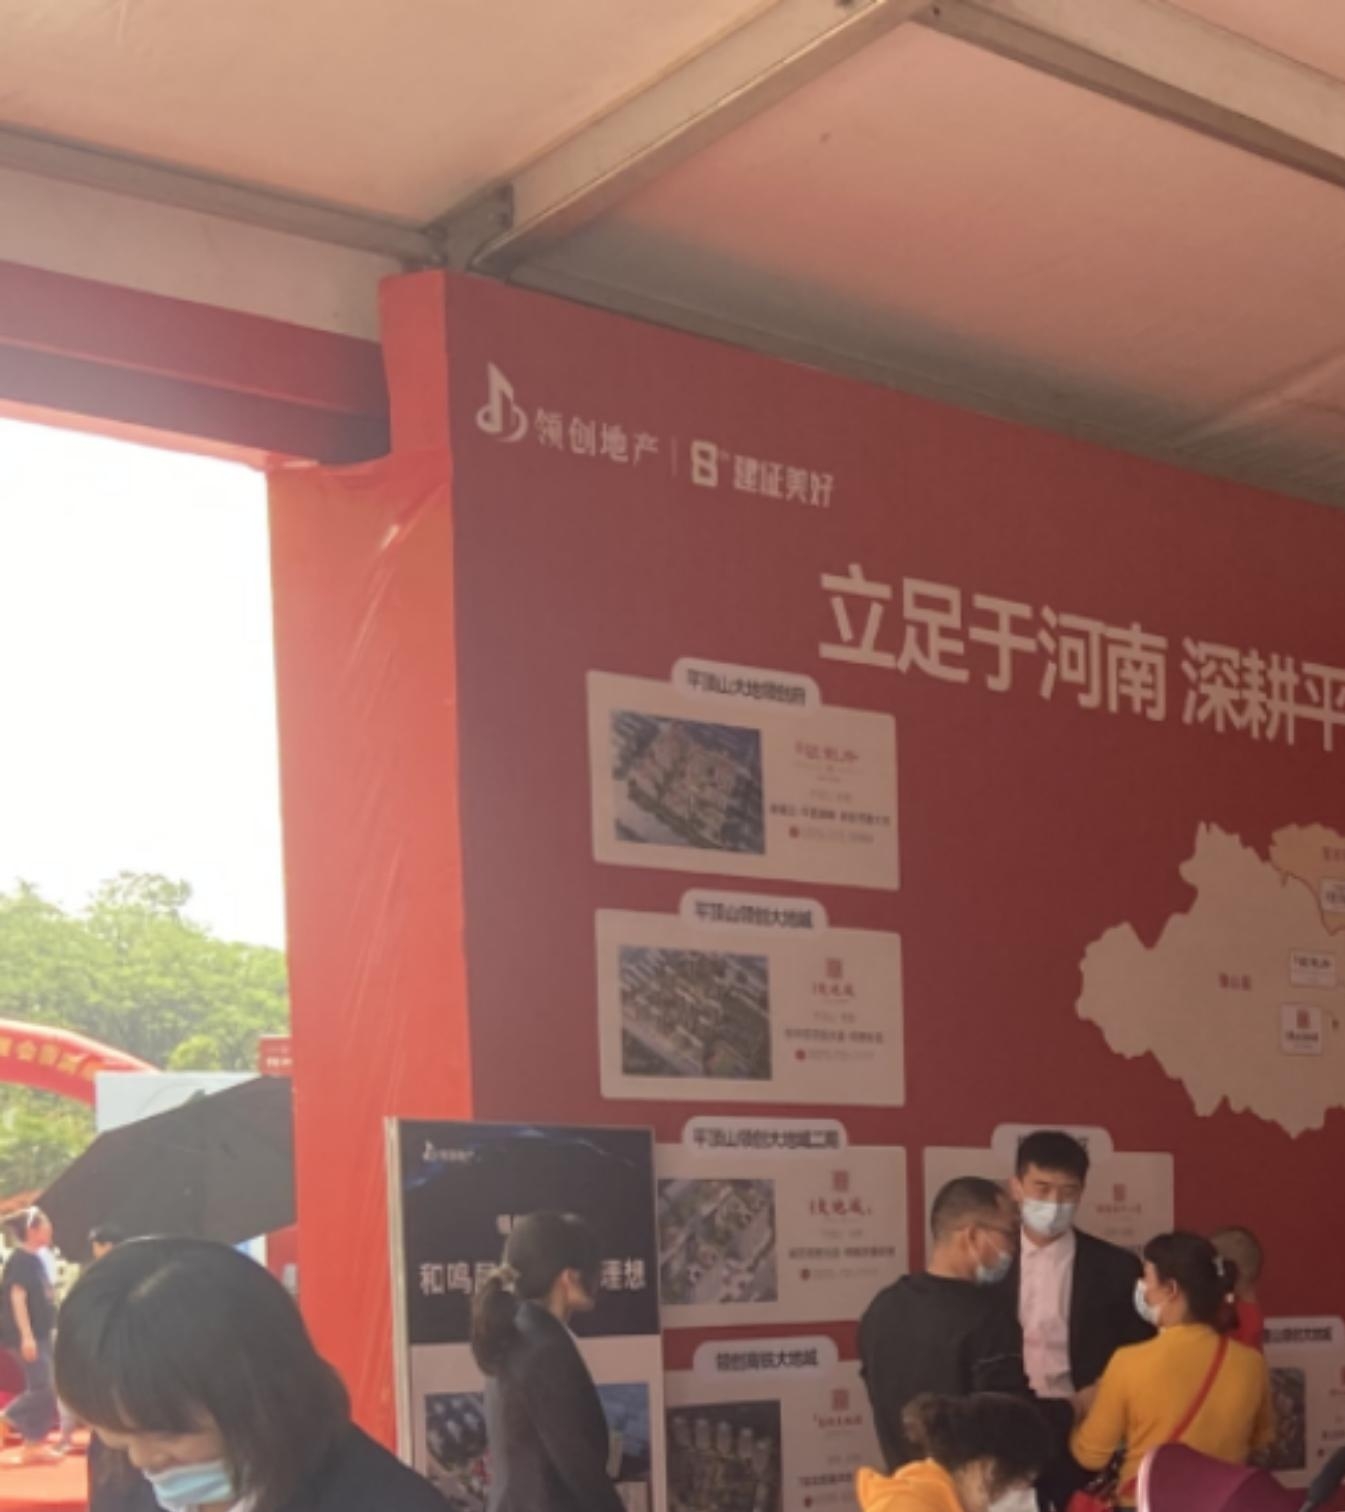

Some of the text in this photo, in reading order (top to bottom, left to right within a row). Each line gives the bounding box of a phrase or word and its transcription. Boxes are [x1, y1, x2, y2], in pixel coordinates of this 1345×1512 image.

[535, 408, 659, 465] 领创地产
[733, 452, 835, 508] 建证美好
[819, 563, 1169, 722] 立足于河南
